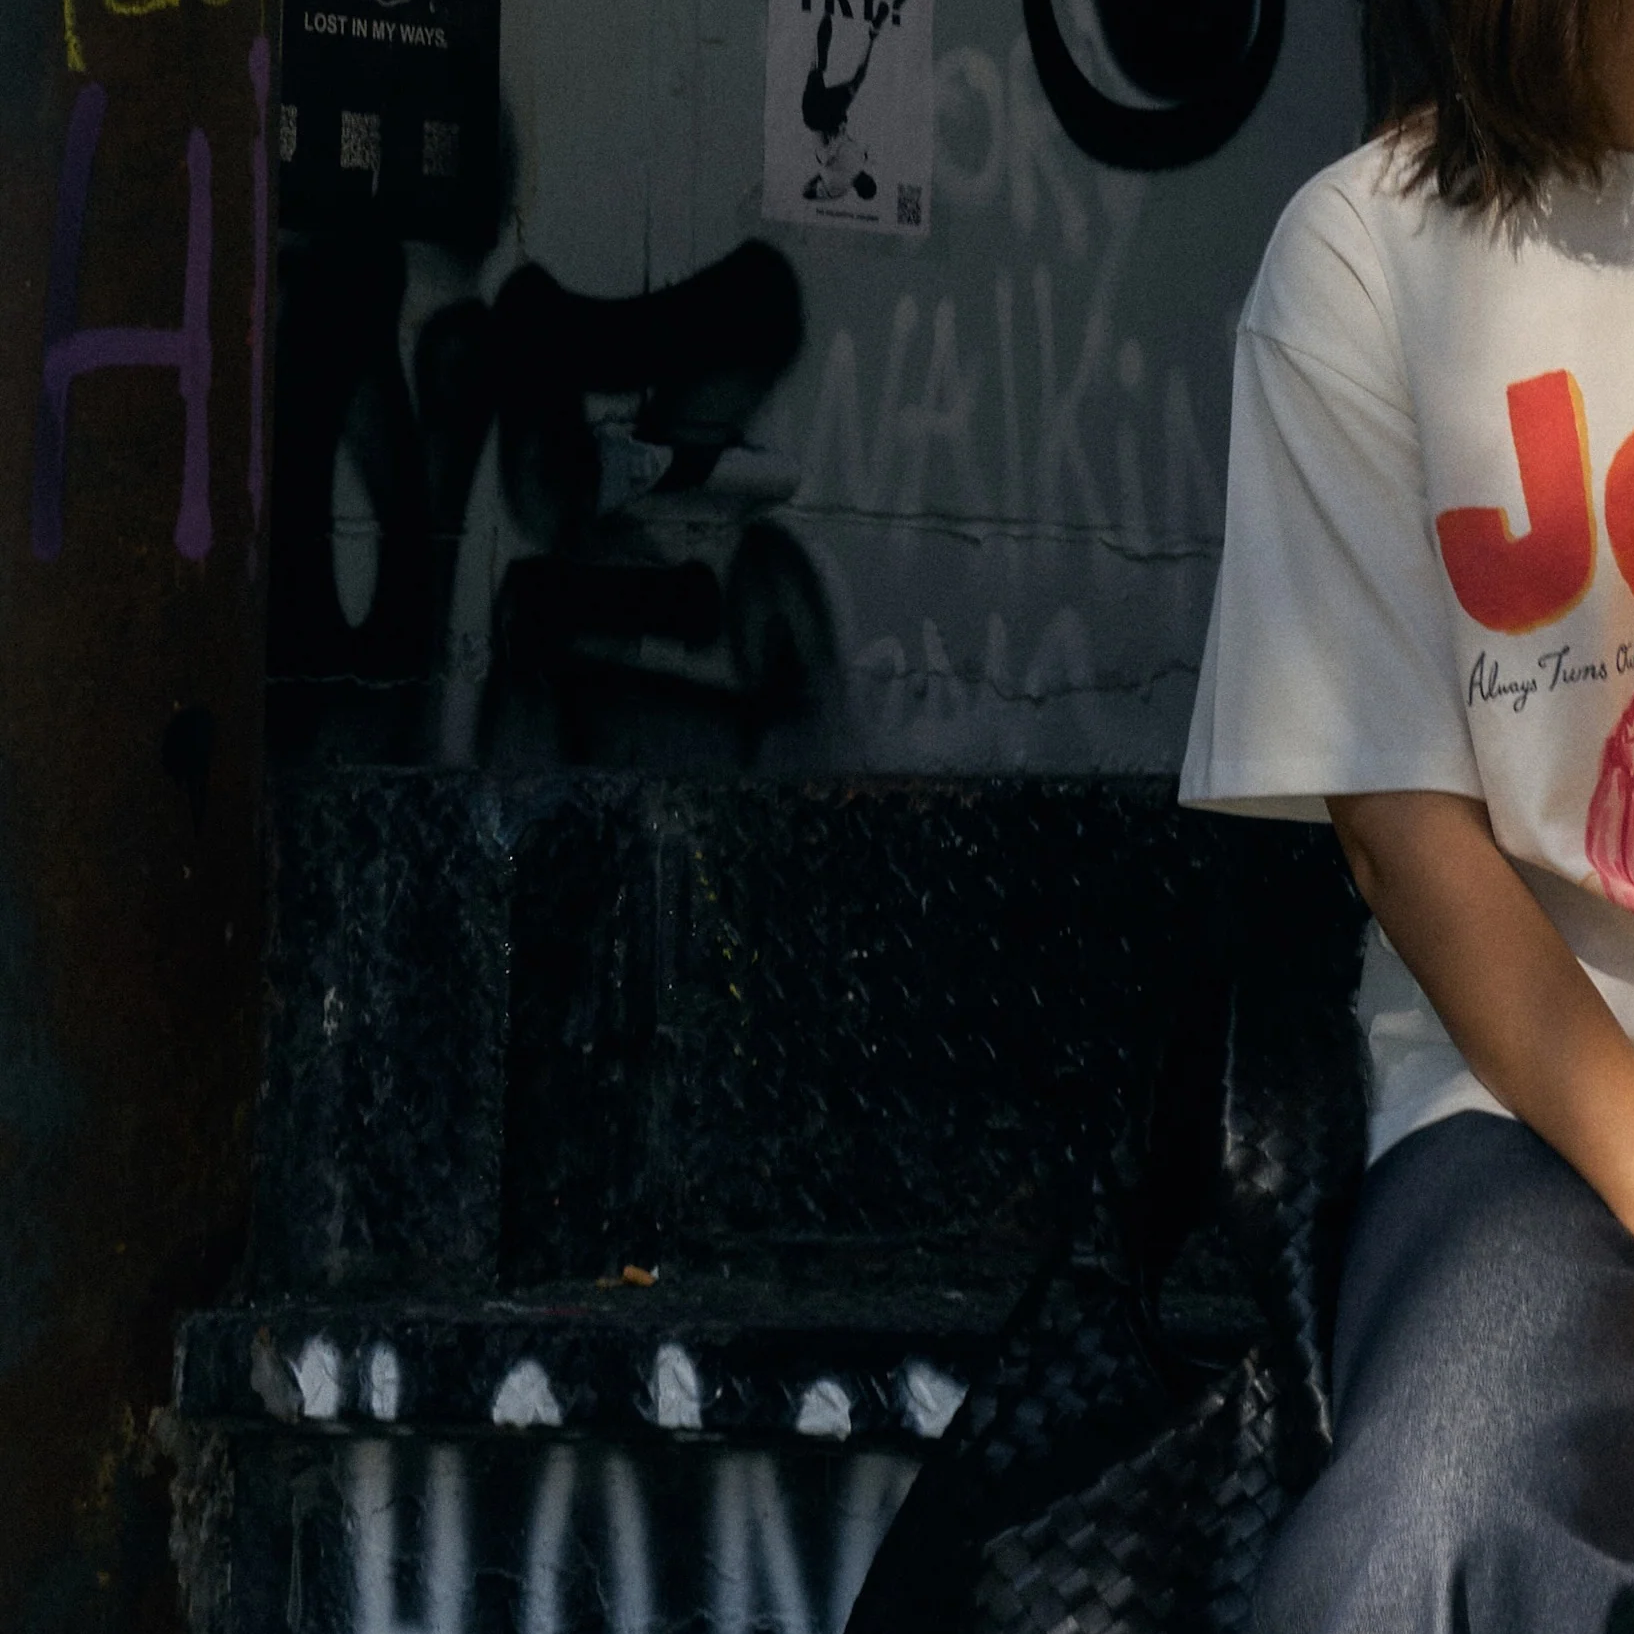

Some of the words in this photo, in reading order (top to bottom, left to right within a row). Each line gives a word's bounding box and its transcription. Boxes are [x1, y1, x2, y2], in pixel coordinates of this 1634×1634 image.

[303, 10, 348, 37] LOST
[351, 17, 368, 38] IN
[371, 20, 396, 43] MY
[1468, 650, 1538, 713] Always
